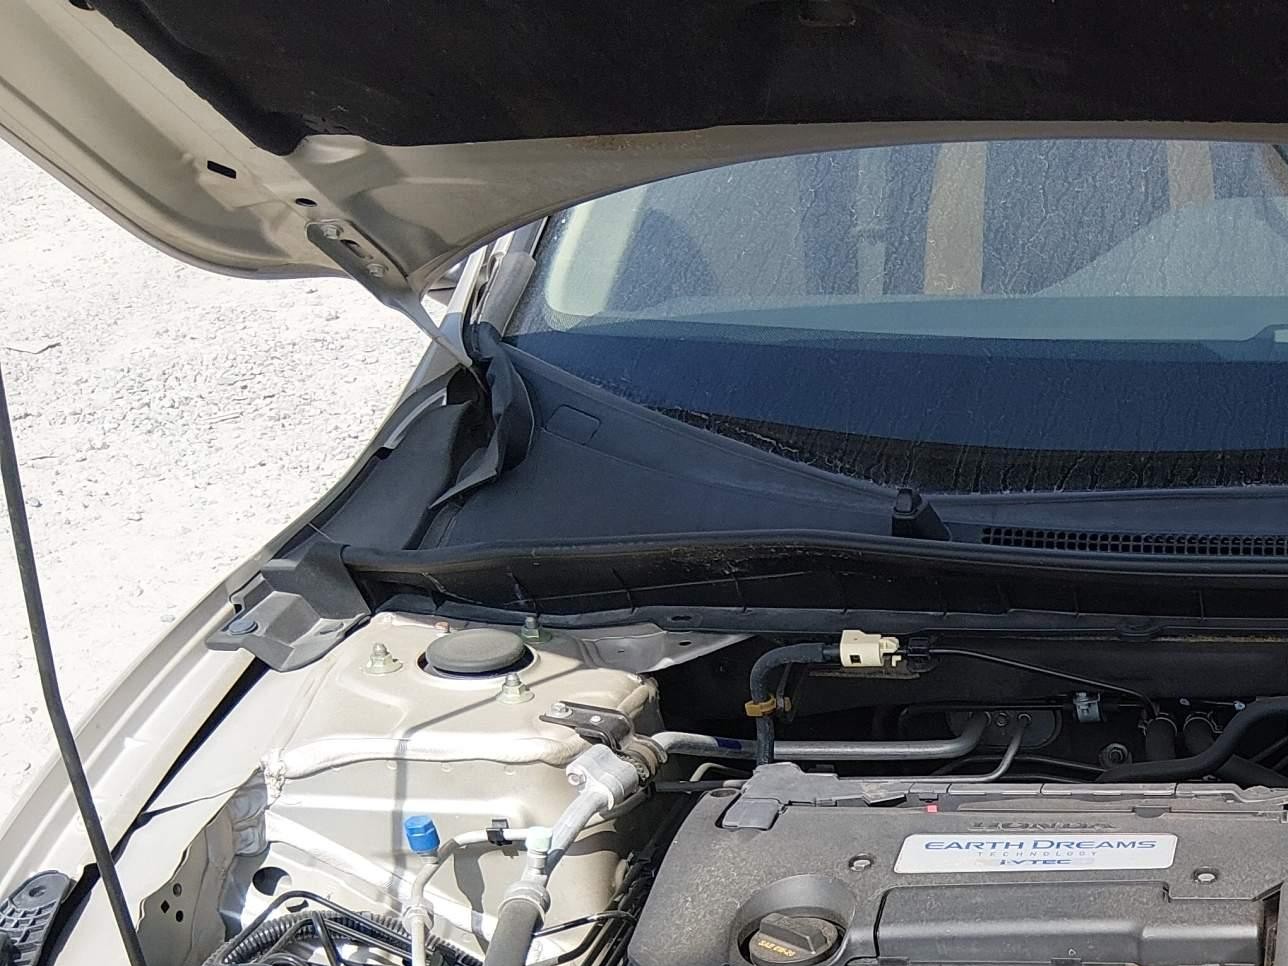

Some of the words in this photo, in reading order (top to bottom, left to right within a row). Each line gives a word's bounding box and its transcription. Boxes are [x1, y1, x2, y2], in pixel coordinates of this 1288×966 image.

[968, 822, 1120, 832] HONDA
[924, 840, 1024, 850] EARTH
[1032, 839, 1157, 850] DREAMS
